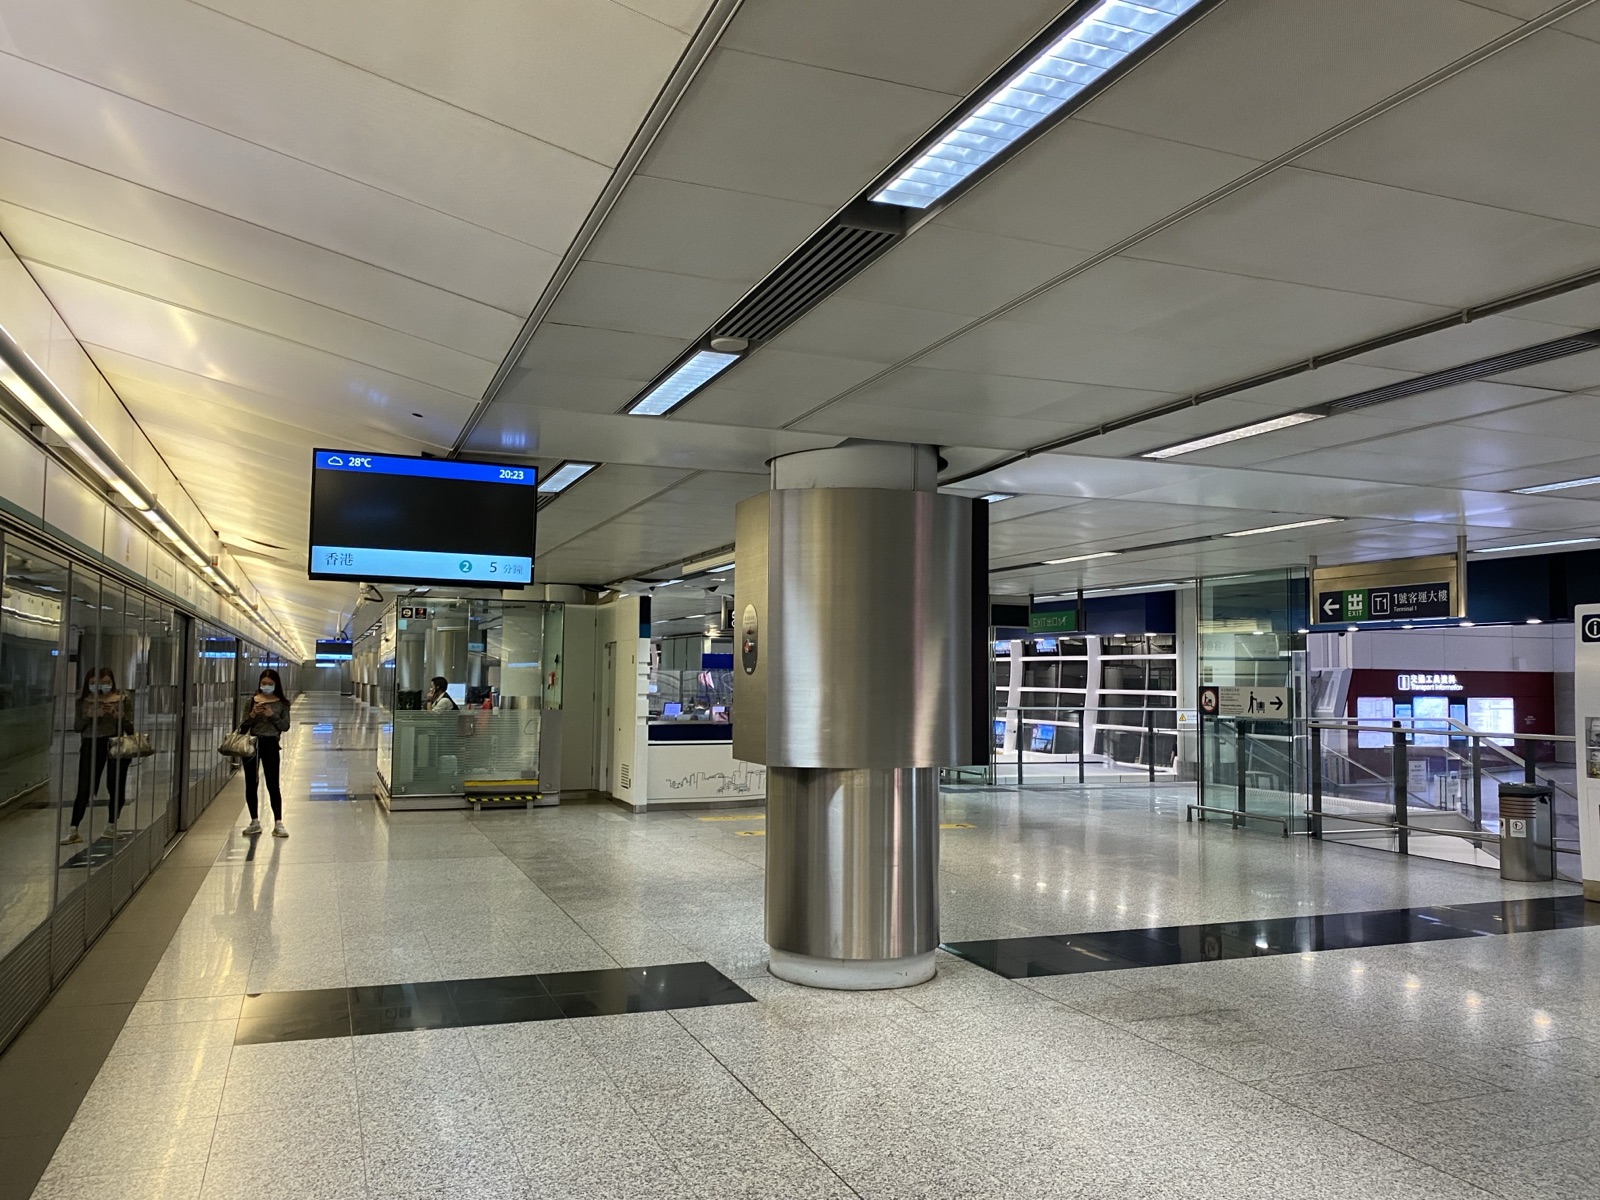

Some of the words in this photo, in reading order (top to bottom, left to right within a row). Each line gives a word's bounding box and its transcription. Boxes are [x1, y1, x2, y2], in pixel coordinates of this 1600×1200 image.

[499, 469, 524, 480] 20:23
[325, 552, 354, 567] 香港
[490, 562, 497, 573] 5
[503, 564, 523, 575] 分鐘
[1374, 597, 1387, 611] T1
[1410, 683, 1435, 691] Transport
